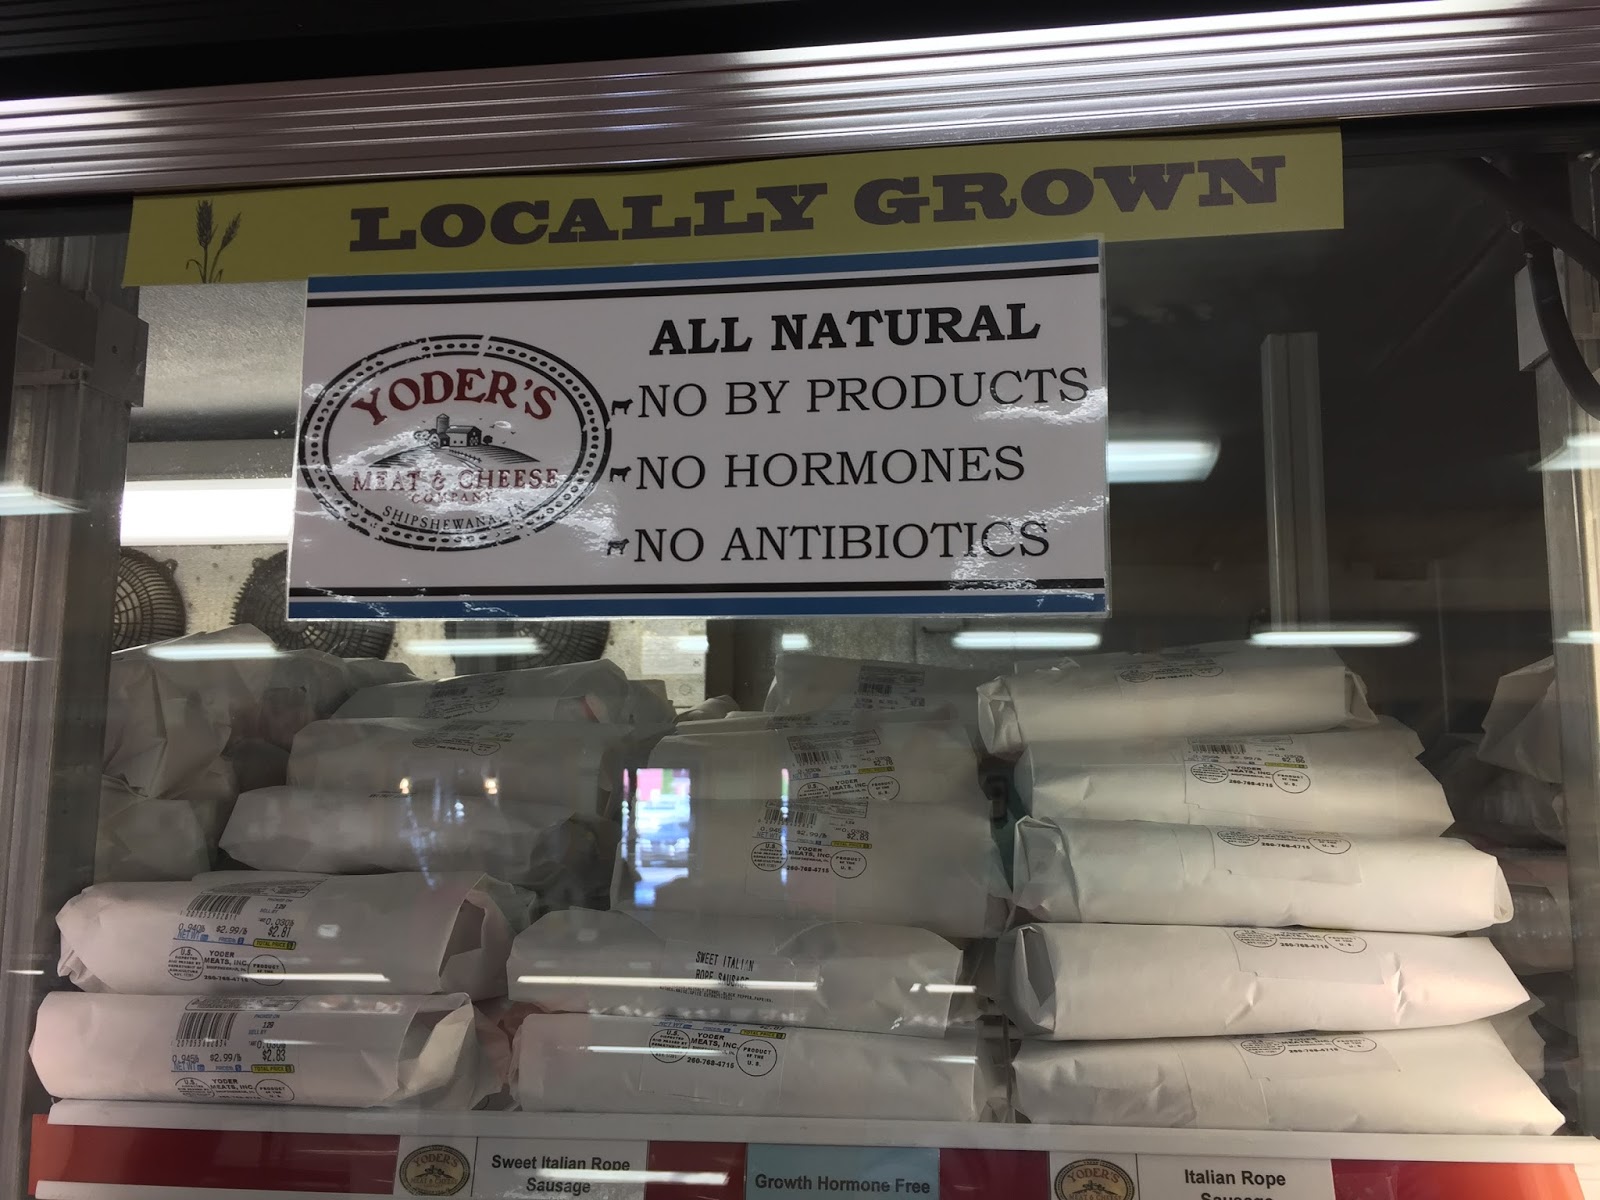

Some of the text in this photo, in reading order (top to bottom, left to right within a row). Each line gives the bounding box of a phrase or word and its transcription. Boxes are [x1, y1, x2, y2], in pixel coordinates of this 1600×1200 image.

[349, 155, 1286, 252] LOCALLY GROWN
[649, 303, 1041, 356] ALL NATURAL
[350, 367, 557, 426] YODER'S
[638, 367, 1090, 418] NO BY PRODUCTS
[636, 445, 1026, 490] NO HORMONES
[352, 471, 421, 491] MEAT
[459, 469, 559, 490] CHEESE
[411, 491, 493, 504] COMPANY
[634, 521, 1051, 563] NO ANTIBIOTICS
[268, 926, 292, 938] $2.81
[204, 957, 232, 966] MEATS,
[209, 950, 235, 958] YODER
[695, 951, 755, 972] SWEET ITALIAN
[690, 1038, 720, 1047] MEATS,
[697, 1032, 725, 1040] YODER
[262, 1049, 286, 1062] $2.83
[743, 1047, 772, 1055] PRODUCT
[687, 1057, 735, 1069] 260-768-4715
[491, 1154, 631, 1172] Sweet Italian Rope
[755, 1173, 931, 1194] Growth Hormone Free
[1067, 1168, 1120, 1184] YODER'S
[1184, 1168, 1287, 1189] Italian Rope
[526, 1177, 591, 1197] Sausage
